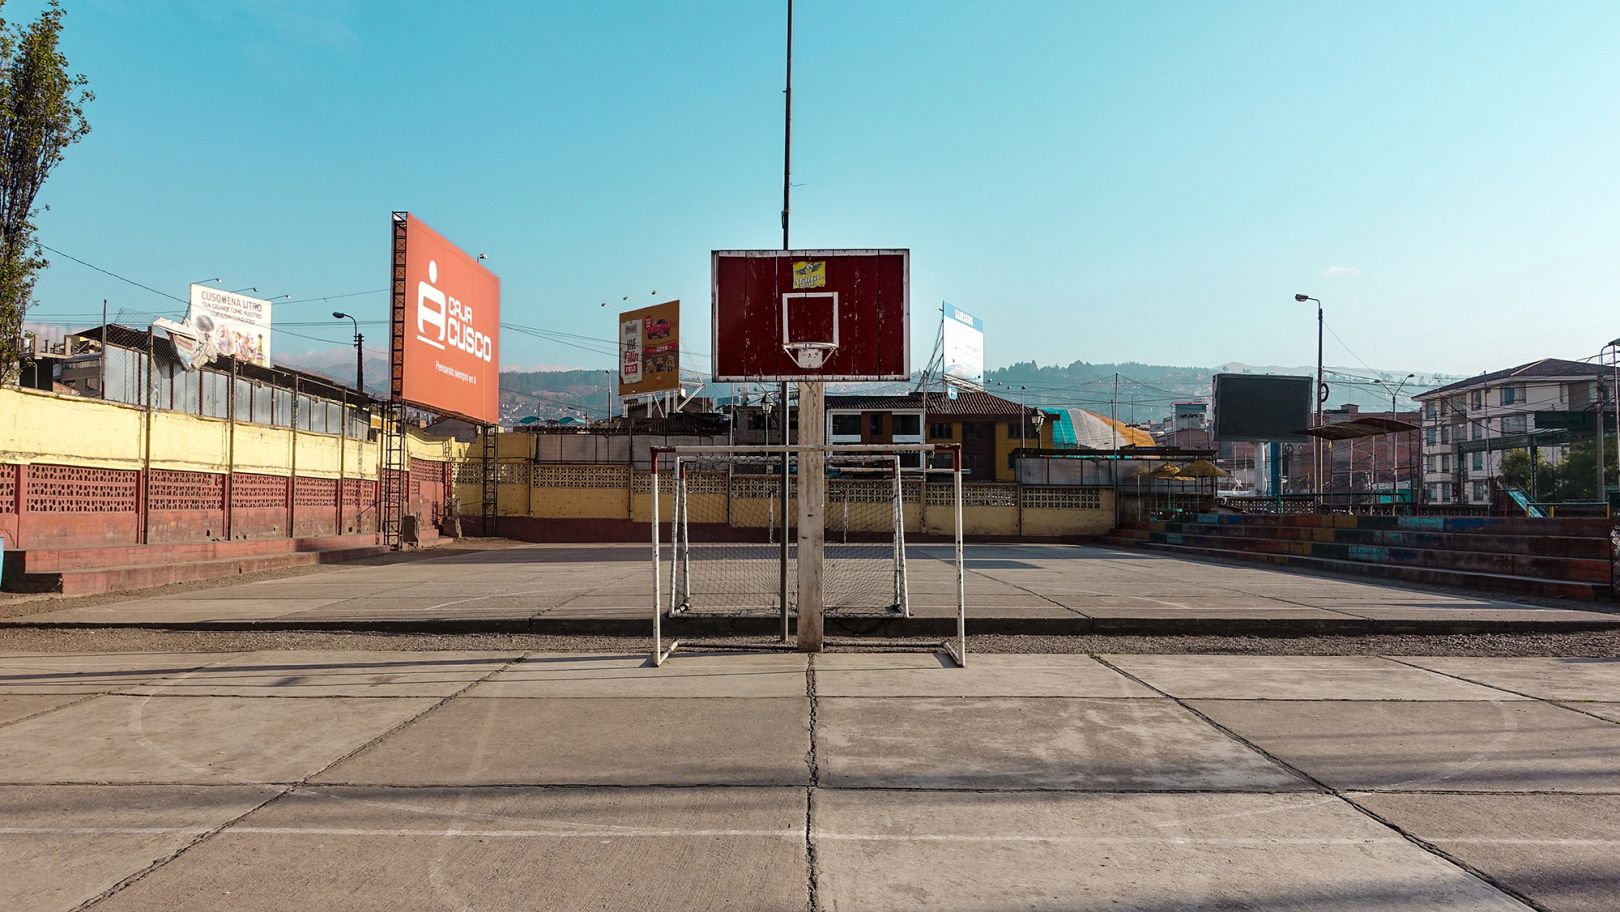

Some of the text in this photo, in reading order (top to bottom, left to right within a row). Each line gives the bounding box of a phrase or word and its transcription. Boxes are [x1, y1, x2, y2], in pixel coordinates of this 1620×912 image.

[242, 299, 263, 313] LITRO
[448, 295, 473, 326] CAJA
[447, 316, 492, 363] CUSCO
